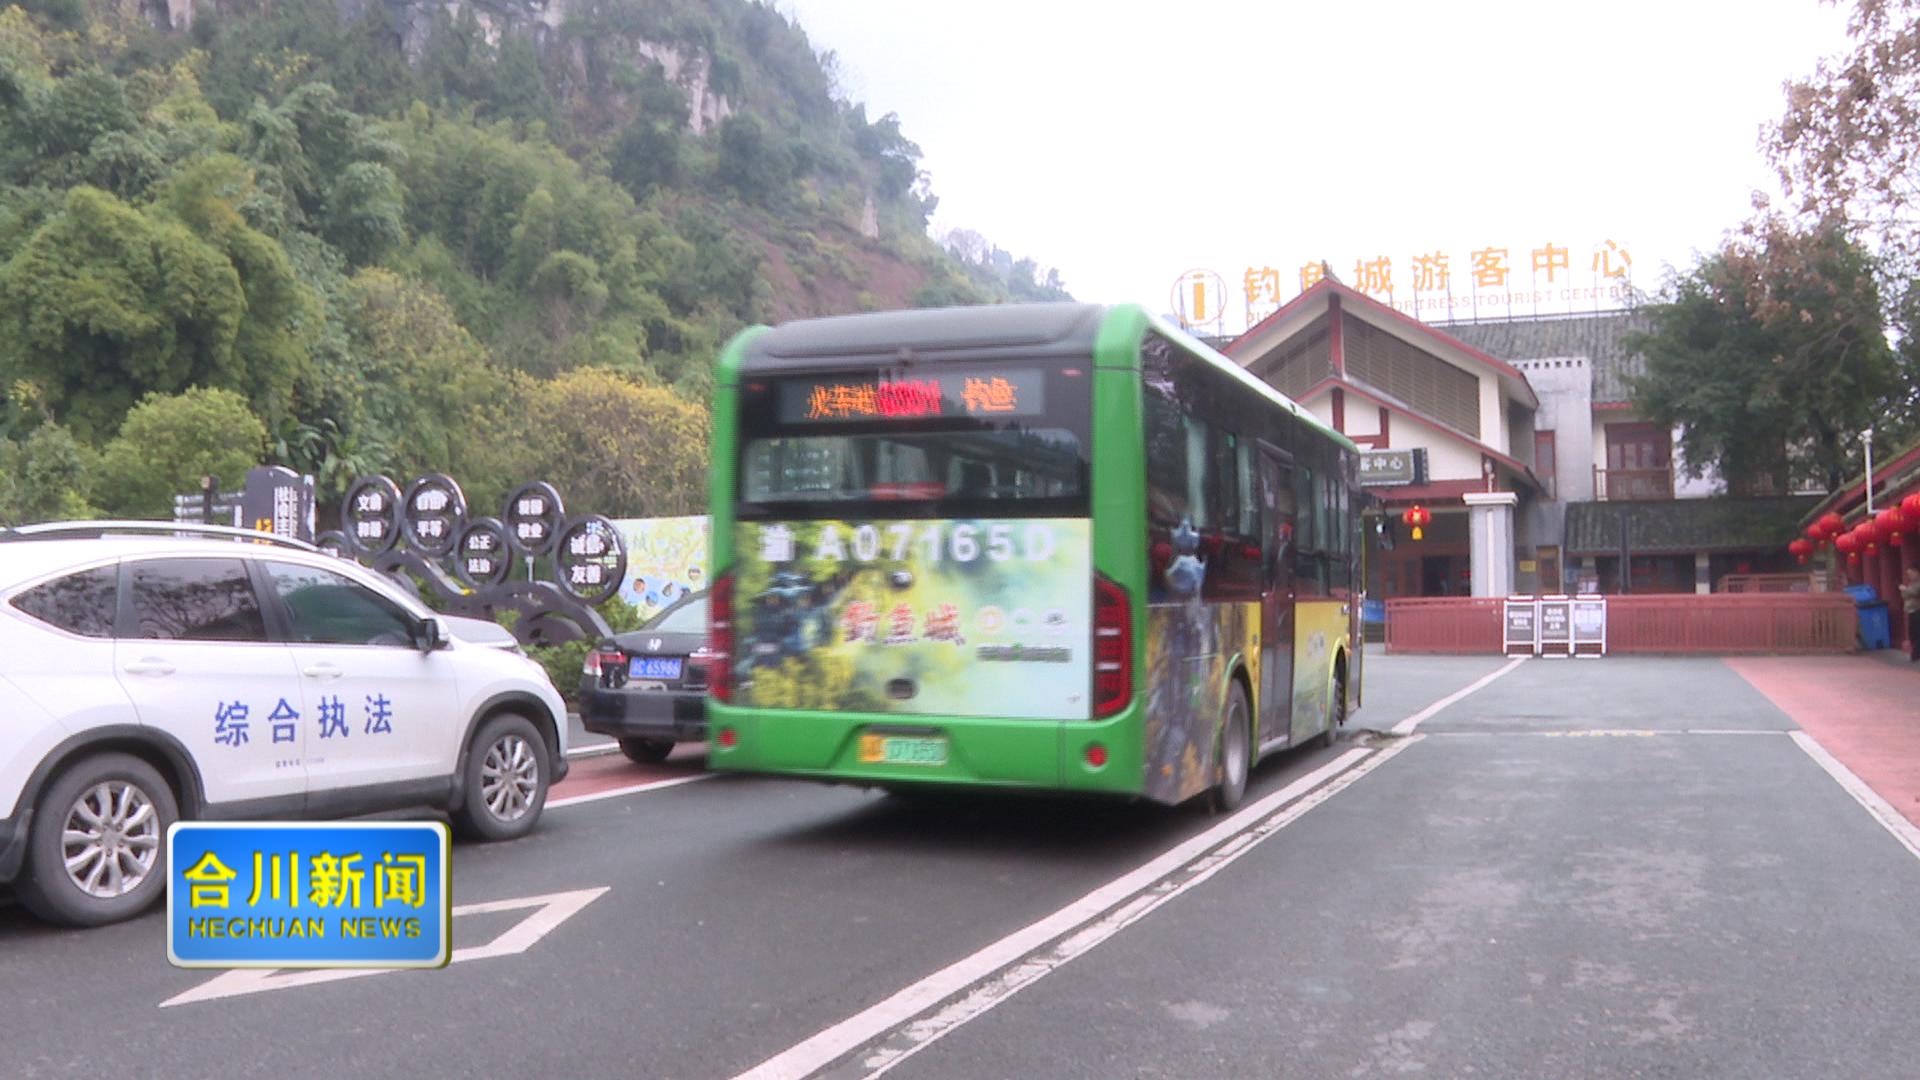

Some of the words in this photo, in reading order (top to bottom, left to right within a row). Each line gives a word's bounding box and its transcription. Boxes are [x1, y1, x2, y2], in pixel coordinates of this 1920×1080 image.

[1243, 239, 1632, 304] 钓鱼城游客中心
[1386, 295, 1471, 311] ORTRESS
[1475, 289, 1553, 306] TOURIST
[214, 693, 392, 748] 综合执法
